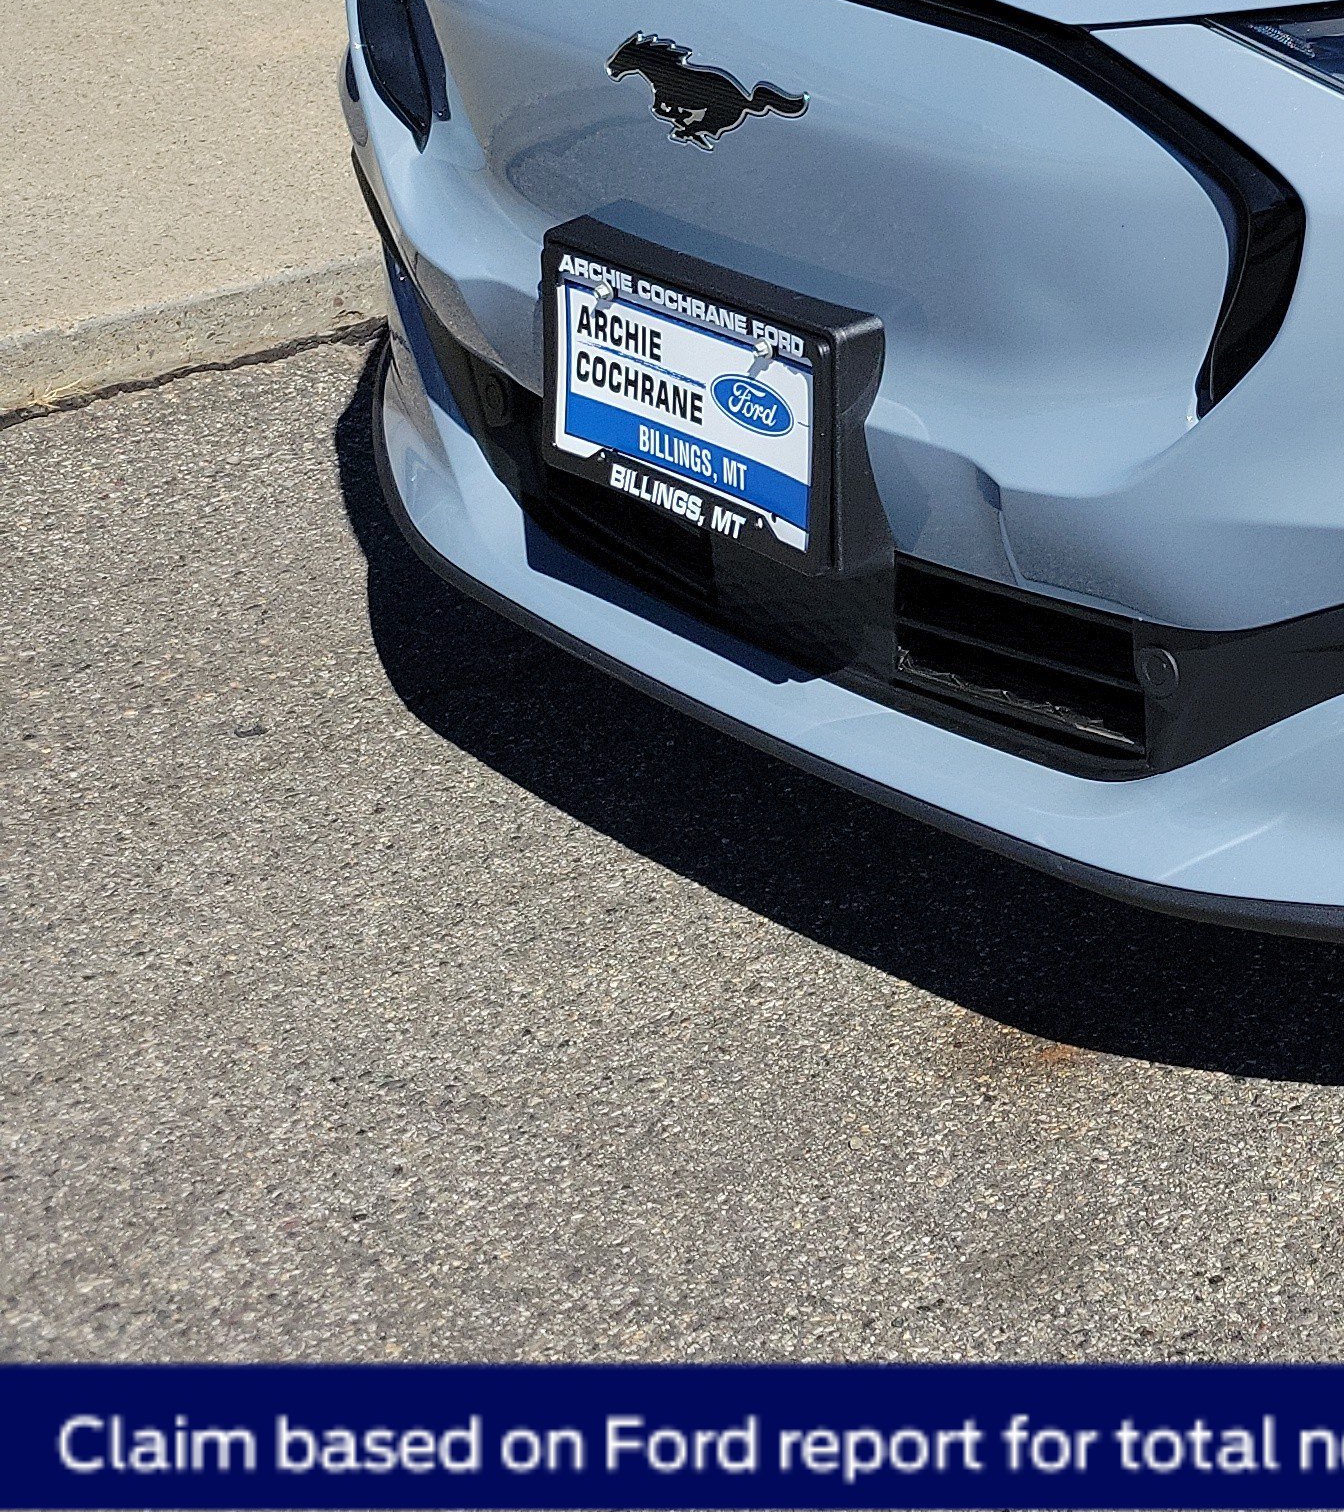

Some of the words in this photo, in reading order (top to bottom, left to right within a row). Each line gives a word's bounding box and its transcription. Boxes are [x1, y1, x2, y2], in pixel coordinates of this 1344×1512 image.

[559, 254, 633, 292] ARCHIE
[637, 279, 747, 333] COCHRANE
[751, 320, 804, 357] FORD
[577, 304, 662, 363] ARCHIE
[576, 350, 704, 426] COCHRANE
[727, 381, 778, 427] Ford
[638, 425, 719, 485] BILLINGS,
[722, 456, 747, 491] MT
[611, 465, 705, 525] BILLINGS,
[711, 509, 747, 540] MT
